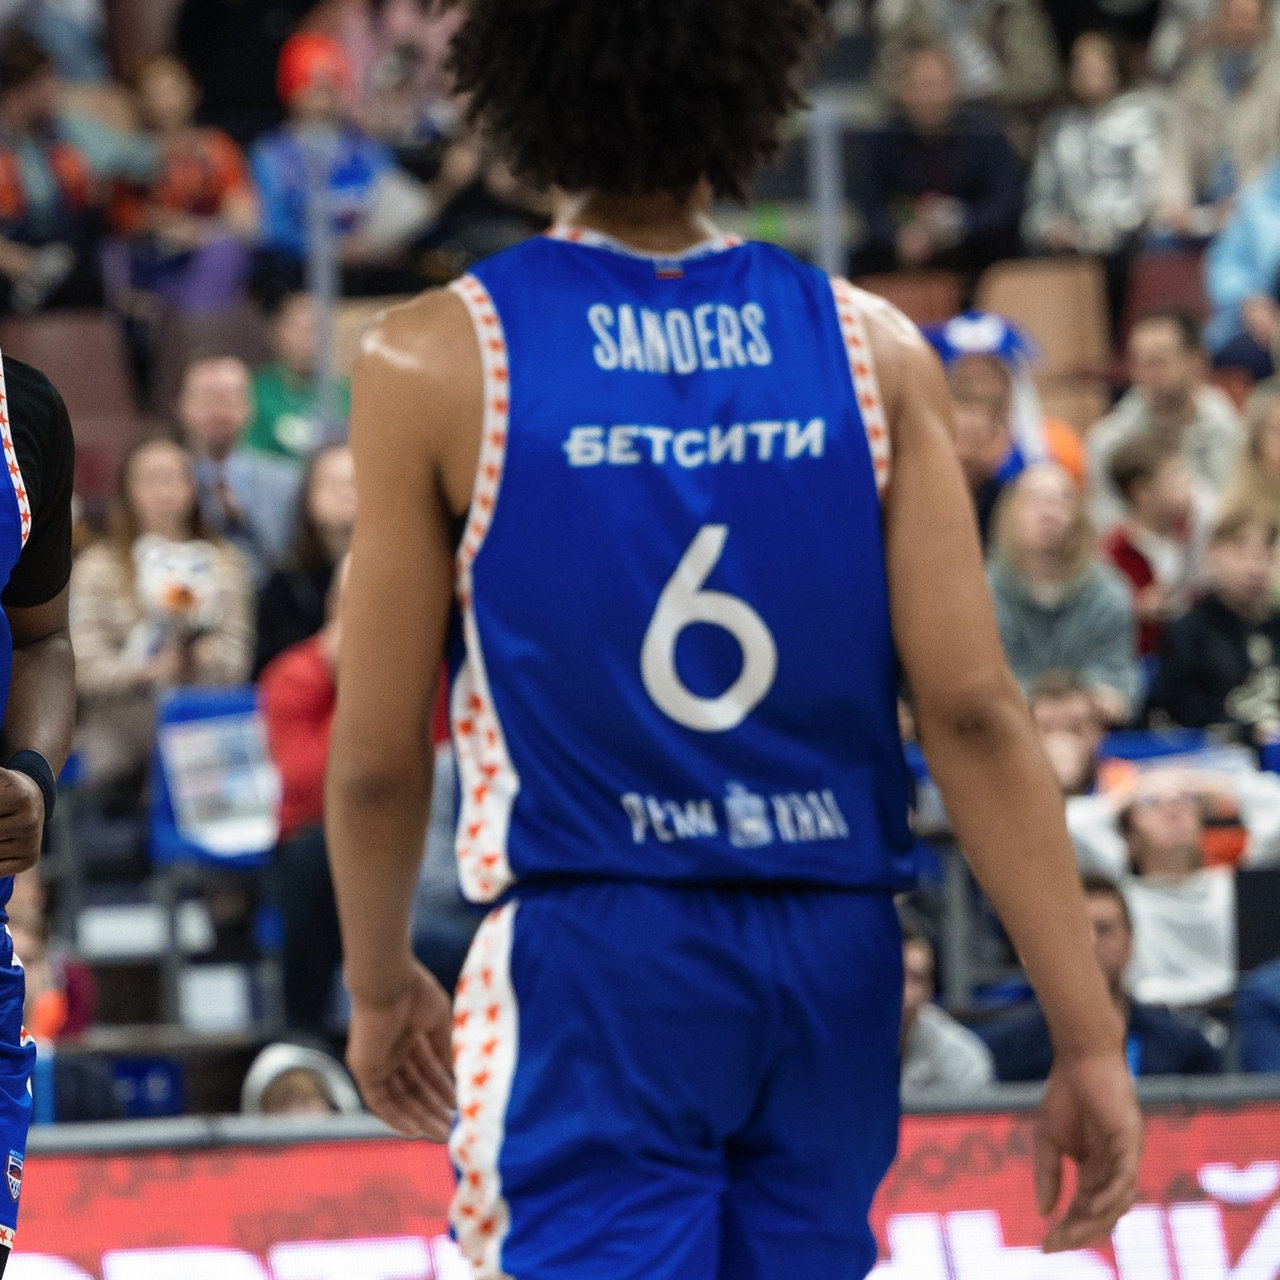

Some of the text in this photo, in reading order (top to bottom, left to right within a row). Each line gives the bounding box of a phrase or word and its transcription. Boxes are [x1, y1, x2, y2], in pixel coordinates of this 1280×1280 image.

[588, 302, 773, 375] SANDERS
[564, 417, 826, 469] БЕТСИТИ
[640, 523, 778, 734] 6
